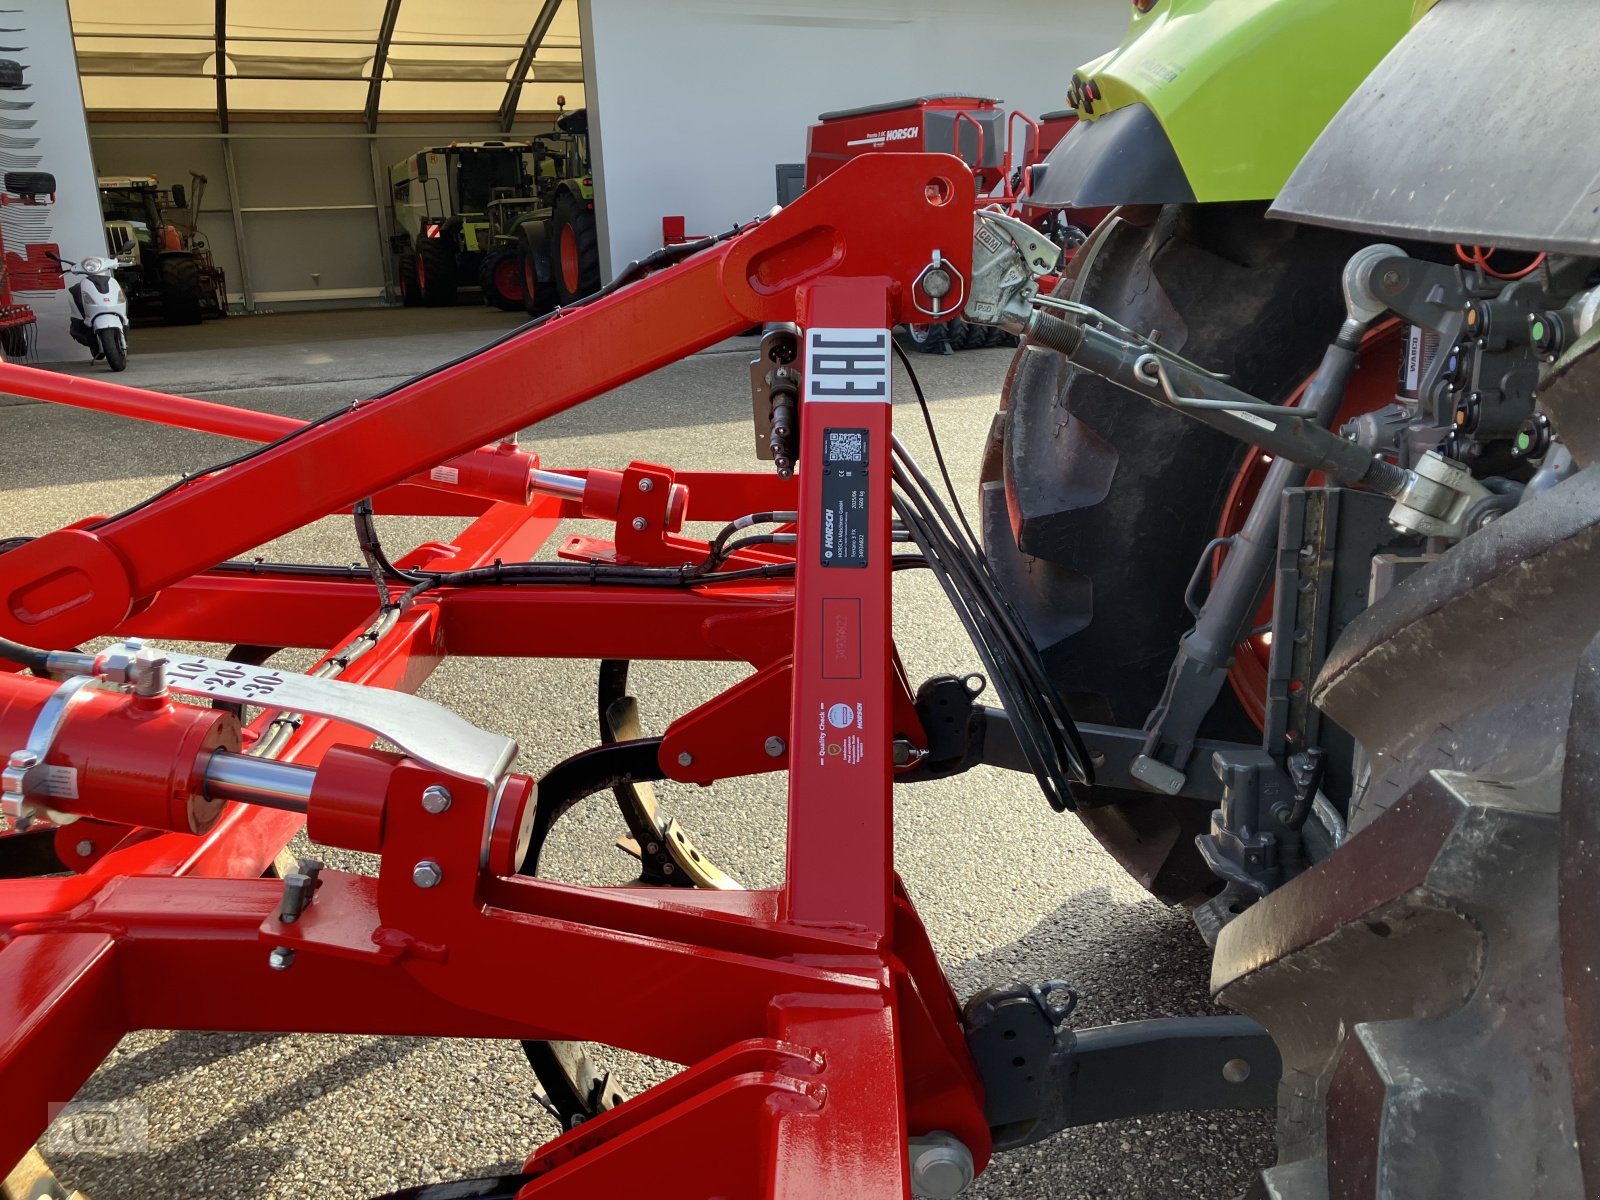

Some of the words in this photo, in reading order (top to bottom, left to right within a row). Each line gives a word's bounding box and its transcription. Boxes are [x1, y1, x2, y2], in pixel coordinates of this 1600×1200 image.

[886, 126, 919, 141] HORSCH
[978, 230, 999, 250] CBM
[812, 334, 885, 396] EAC
[1409, 337, 1418, 372] WABCO
[824, 508, 834, 549] HORSCH
